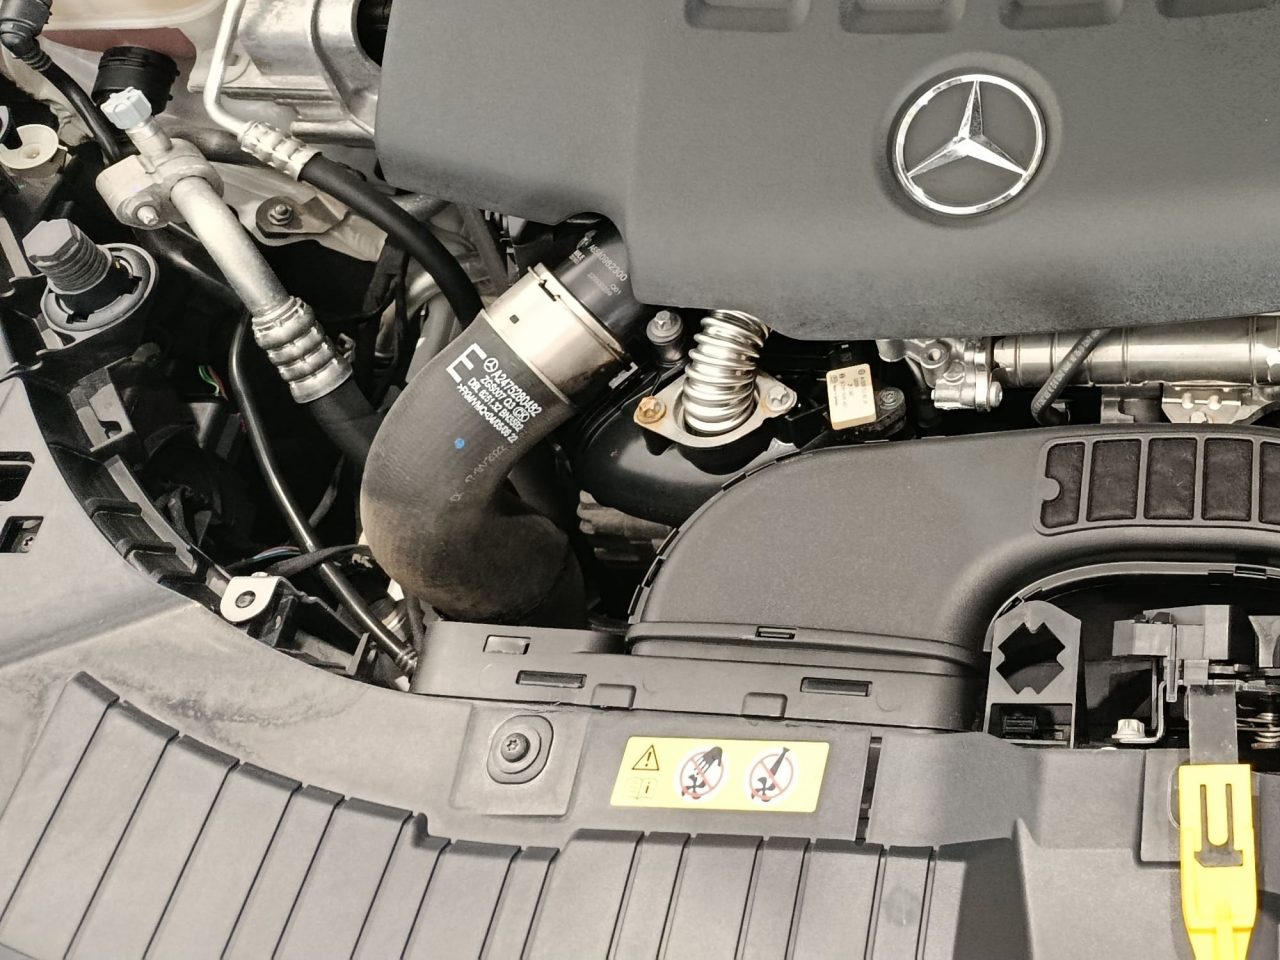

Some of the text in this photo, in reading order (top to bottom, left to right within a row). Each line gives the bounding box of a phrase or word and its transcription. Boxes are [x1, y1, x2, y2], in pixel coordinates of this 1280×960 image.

[446, 342, 487, 383] E
[480, 374, 507, 400] ZGS007
[491, 369, 542, 417] A2475280482
